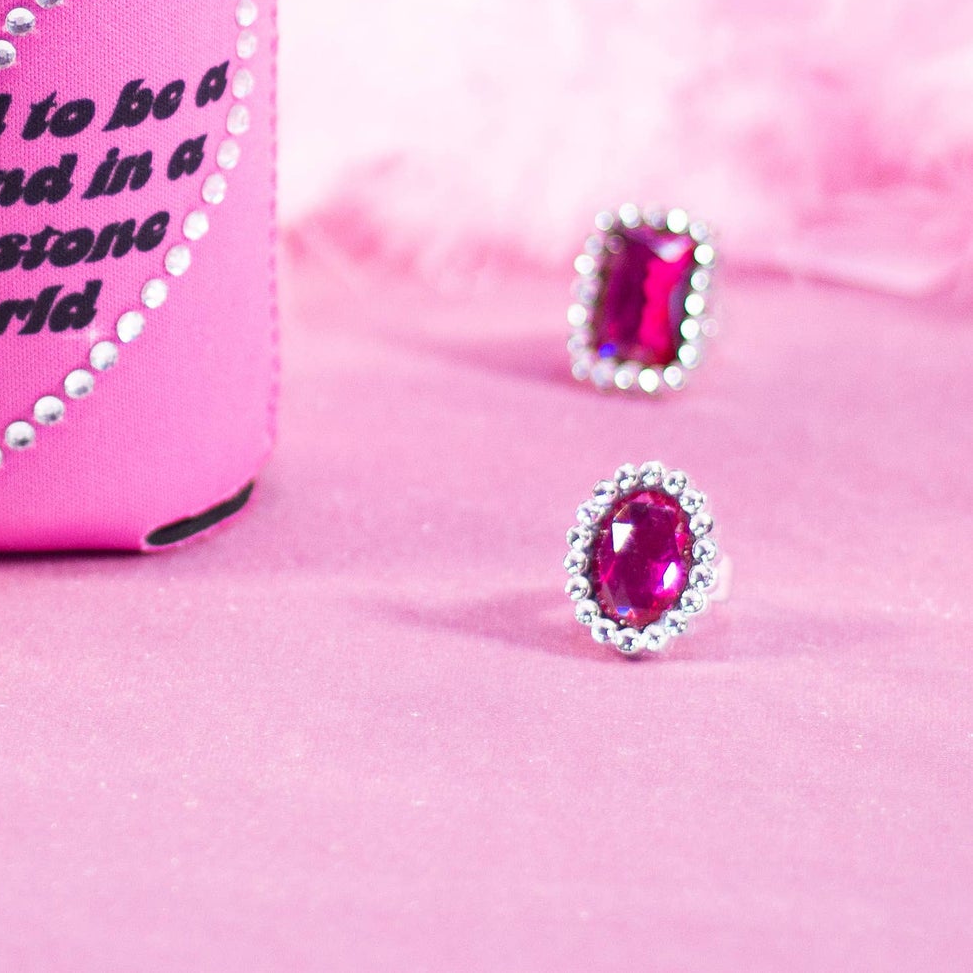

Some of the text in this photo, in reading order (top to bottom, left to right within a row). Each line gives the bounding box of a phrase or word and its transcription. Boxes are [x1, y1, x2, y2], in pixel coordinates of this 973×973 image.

[22, 91, 96, 141] to
[102, 78, 186, 132] be
[195, 61, 229, 108] a
[82, 147, 153, 200] in
[167, 134, 207, 181] a
